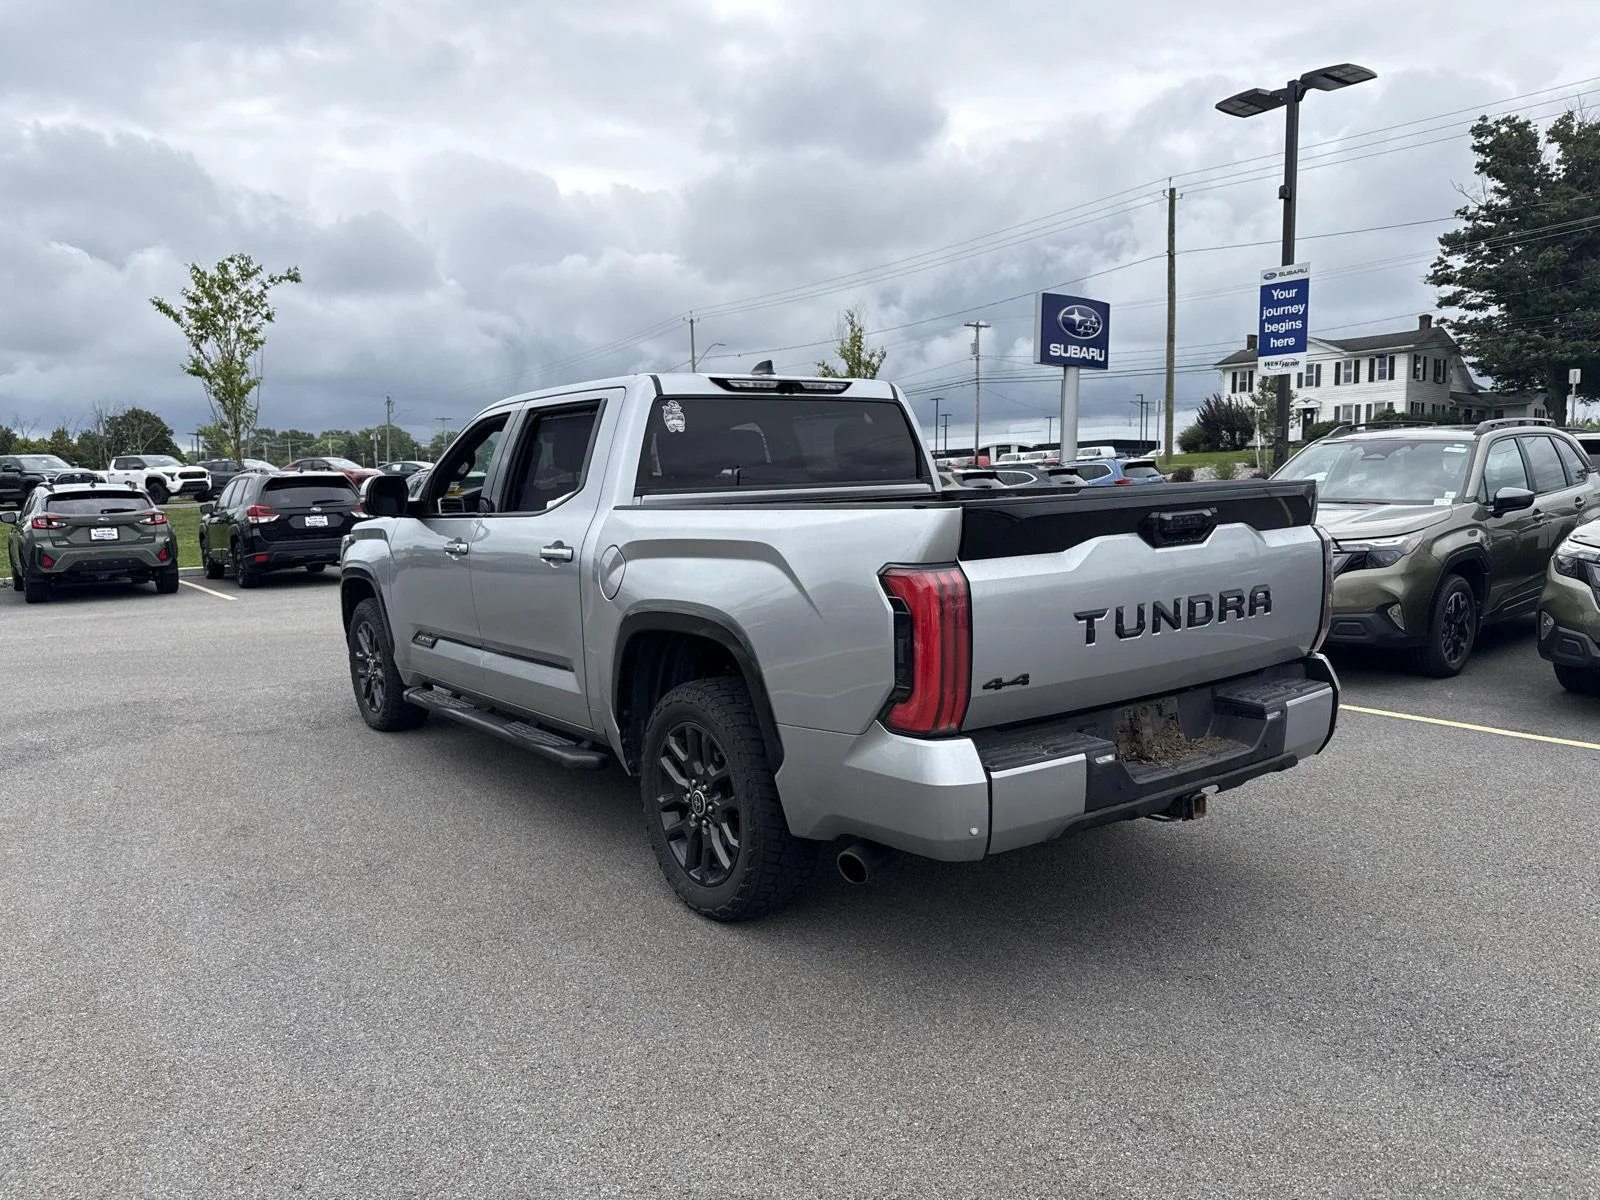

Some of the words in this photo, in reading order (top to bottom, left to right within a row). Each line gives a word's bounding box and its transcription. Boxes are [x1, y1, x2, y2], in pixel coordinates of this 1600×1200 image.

[1278, 268, 1308, 277] SUBARU
[1271, 287, 1298, 300] Your
[1262, 303, 1306, 320] journey
[1264, 319, 1302, 333] begins
[1270, 336, 1296, 348] here
[1049, 343, 1105, 361] SUBARU
[1074, 583, 1272, 647] TUNDRA
